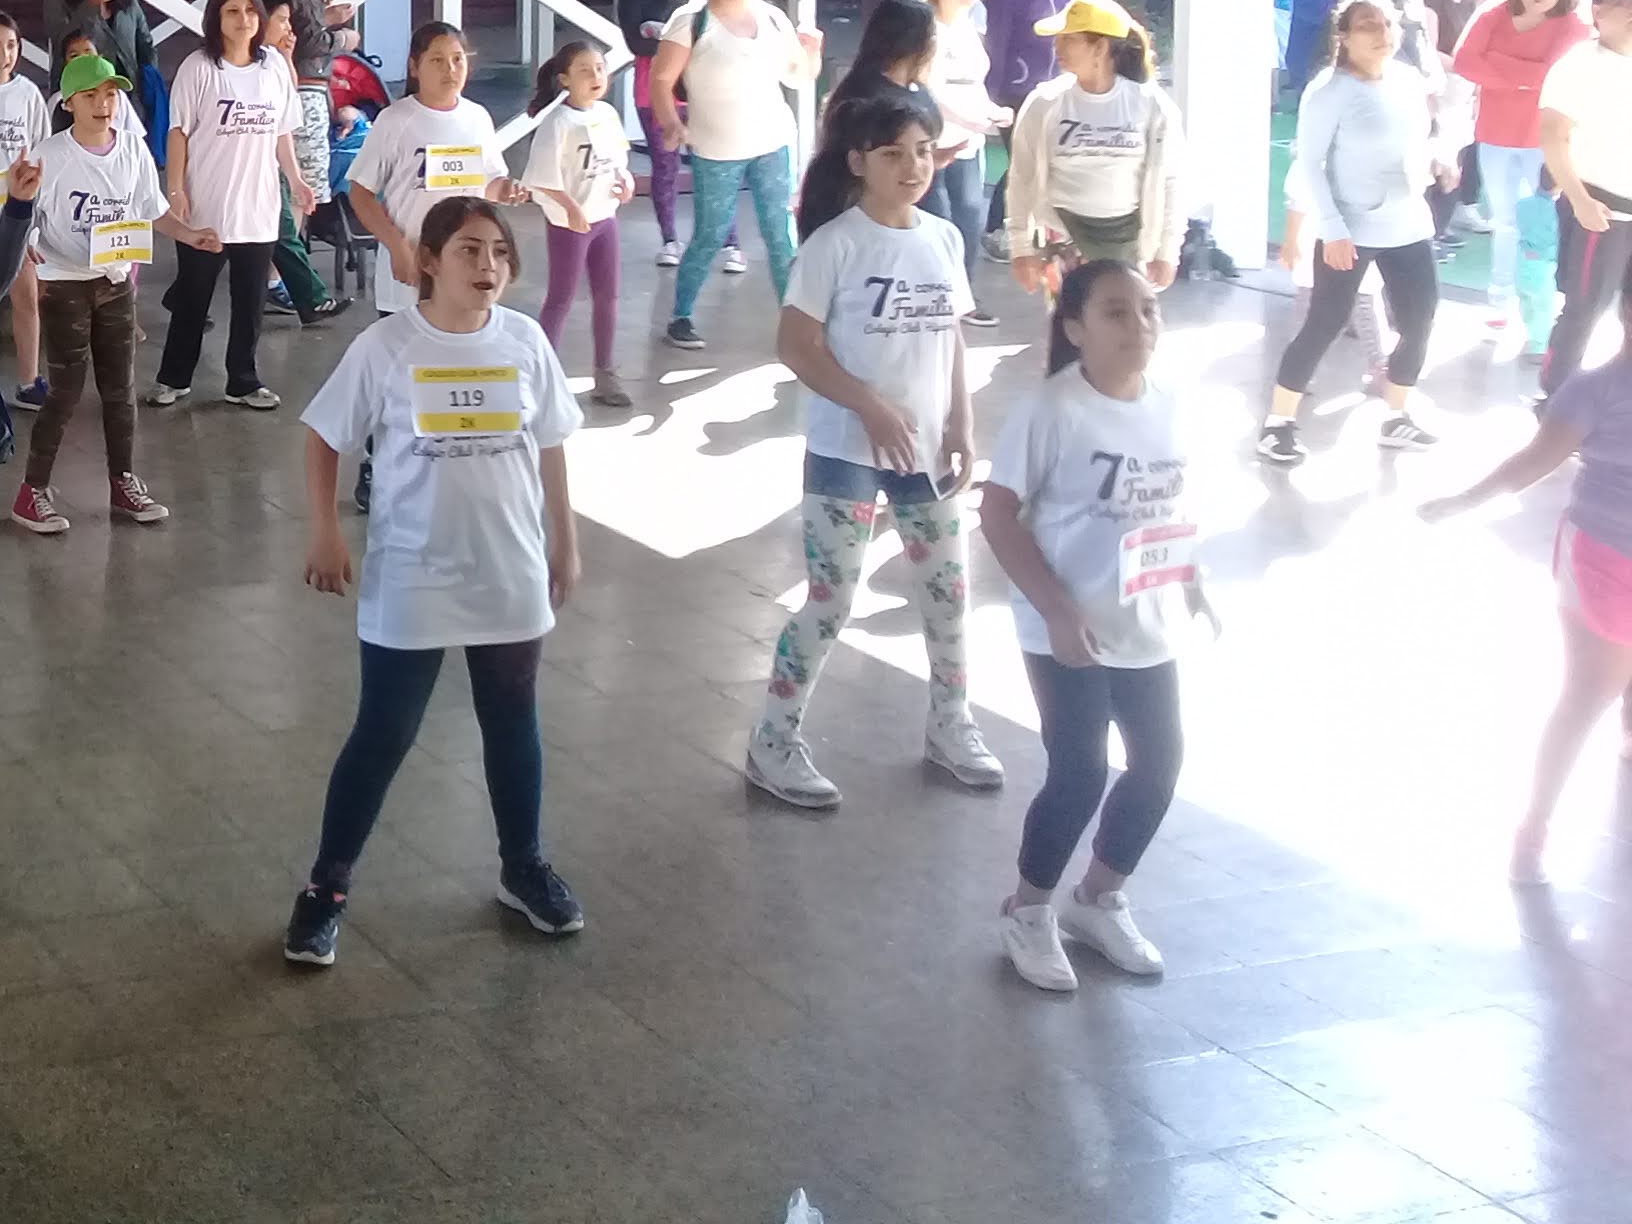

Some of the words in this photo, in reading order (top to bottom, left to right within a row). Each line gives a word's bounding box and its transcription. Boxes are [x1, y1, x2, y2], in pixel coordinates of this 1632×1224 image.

[442, 160, 464, 172] 003
[110, 235, 130, 248] 121
[449, 389, 485, 407] 119
